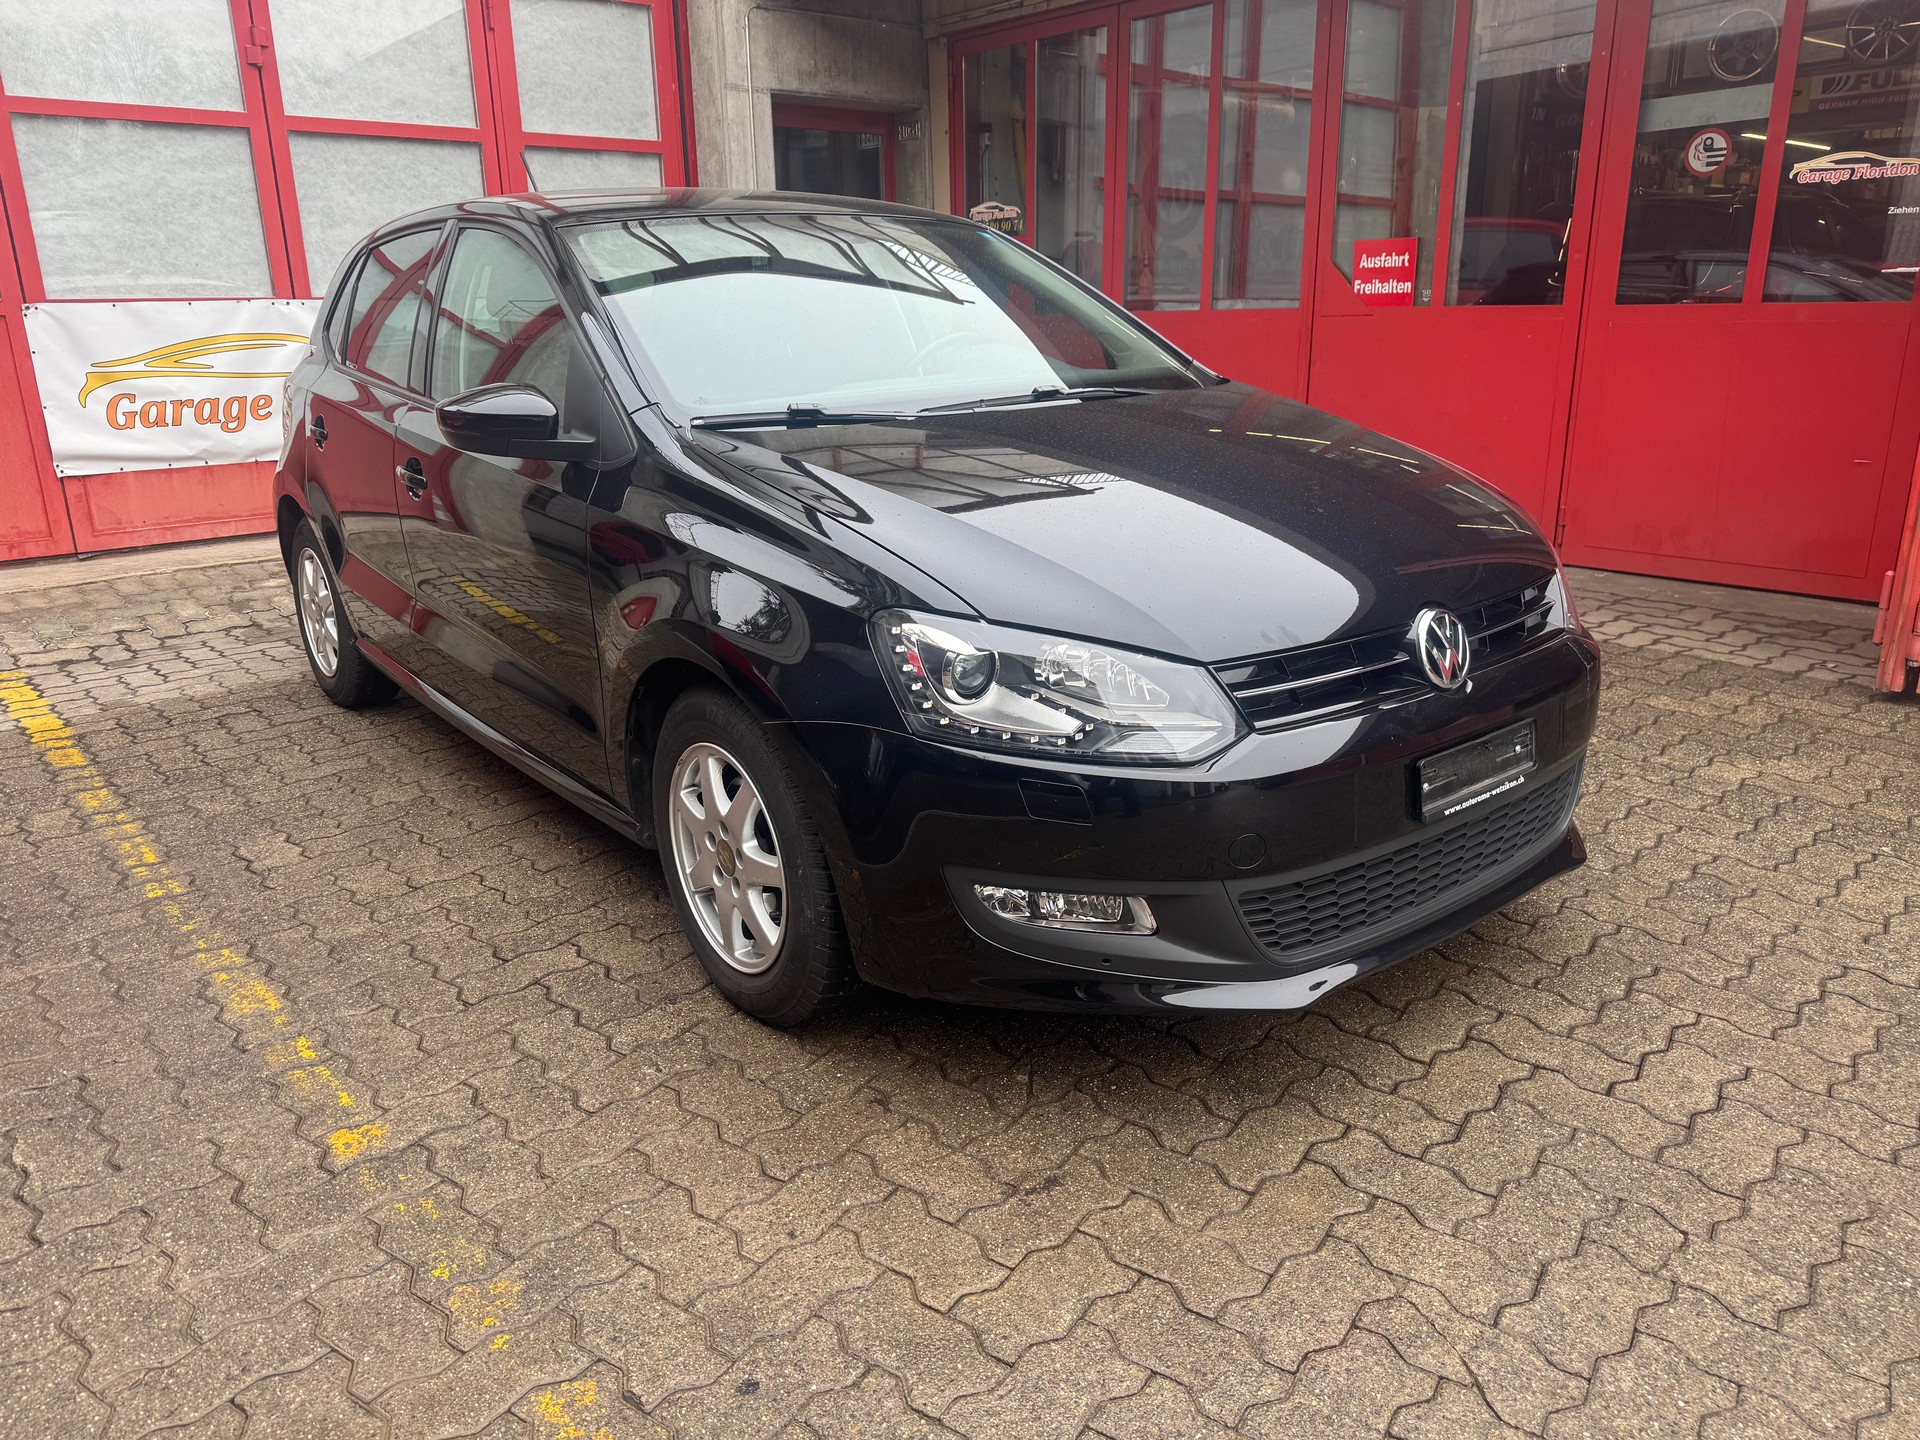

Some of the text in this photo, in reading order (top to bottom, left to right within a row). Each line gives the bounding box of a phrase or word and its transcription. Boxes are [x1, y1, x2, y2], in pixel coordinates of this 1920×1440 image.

[1818, 98, 1859, 110] GERMAN
[1861, 96, 1885, 105] HIGH
[1798, 162, 1919, 184] Garage Floridon
[1887, 206, 1920, 214] Ziehen
[1001, 220, 1011, 231] 90
[1359, 251, 1410, 269] Ausfahrt
[1354, 278, 1412, 294] Freihalten
[106, 392, 273, 433] Garage
[1443, 774, 1525, 816] www.autorama-wetzikon.ch
